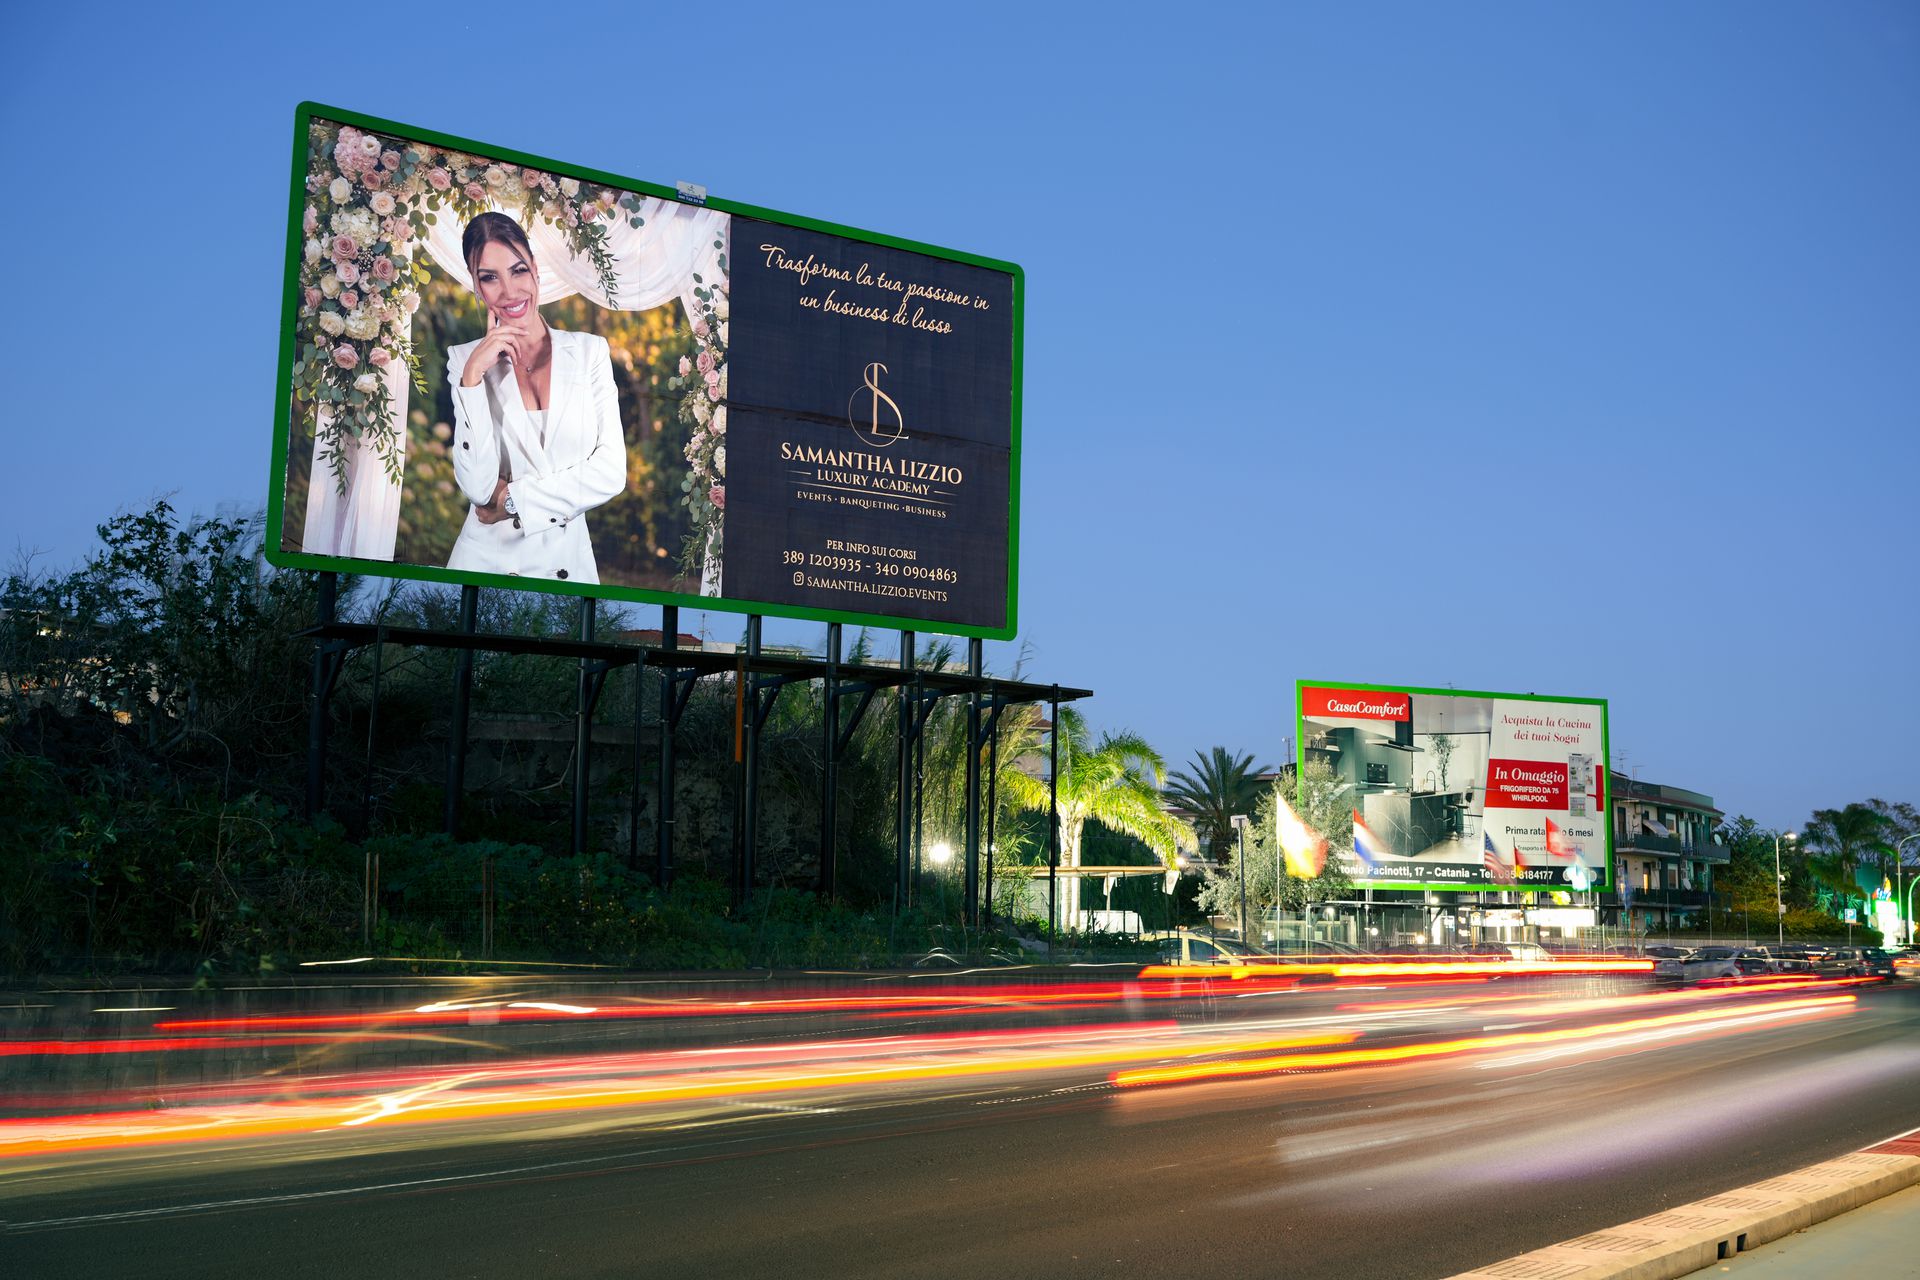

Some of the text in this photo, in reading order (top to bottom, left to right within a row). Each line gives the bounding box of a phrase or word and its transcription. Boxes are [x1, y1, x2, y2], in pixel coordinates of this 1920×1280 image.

[760, 243, 990, 310] Trasforma la tua passione in
[799, 290, 953, 335] un business di lusso
[781, 442, 963, 485] SAMANTHA LIZZIO
[817, 469, 930, 496] LUXURY ACADEMY
[797, 491, 832, 503] EVENTS
[840, 496, 900, 512] BANQUETING
[827, 539, 917, 560] PER INFO SUI CORSI
[783, 551, 805, 565] 389
[809, 553, 861, 572] 1203935
[875, 562, 899, 576] 340
[902, 565, 958, 584] 0904863
[806, 576, 948, 602] SAMANTHA.LIZZIO.EVENTS
[1501, 714, 1592, 729] Acquista la Cucina
[1513, 730, 1580, 745] dei tuoi Sogni
[1495, 767, 1565, 785] In Omaggio
[1500, 785, 1542, 794] FRIGORIFERO
[1511, 794, 1548, 803] WHIRLPOOL
[1505, 826, 1529, 836] Prima
[1530, 827, 1546, 836] rata
[1568, 828, 1574, 837] 6
[1575, 828, 1594, 837] mesi
[1340, 865, 1365, 875] tonio
[1367, 865, 1412, 878] Pacinotti,
[1415, 867, 1424, 876] 17
[1434, 867, 1470, 878] Catania
[1479, 869, 1496, 879] Tel.
